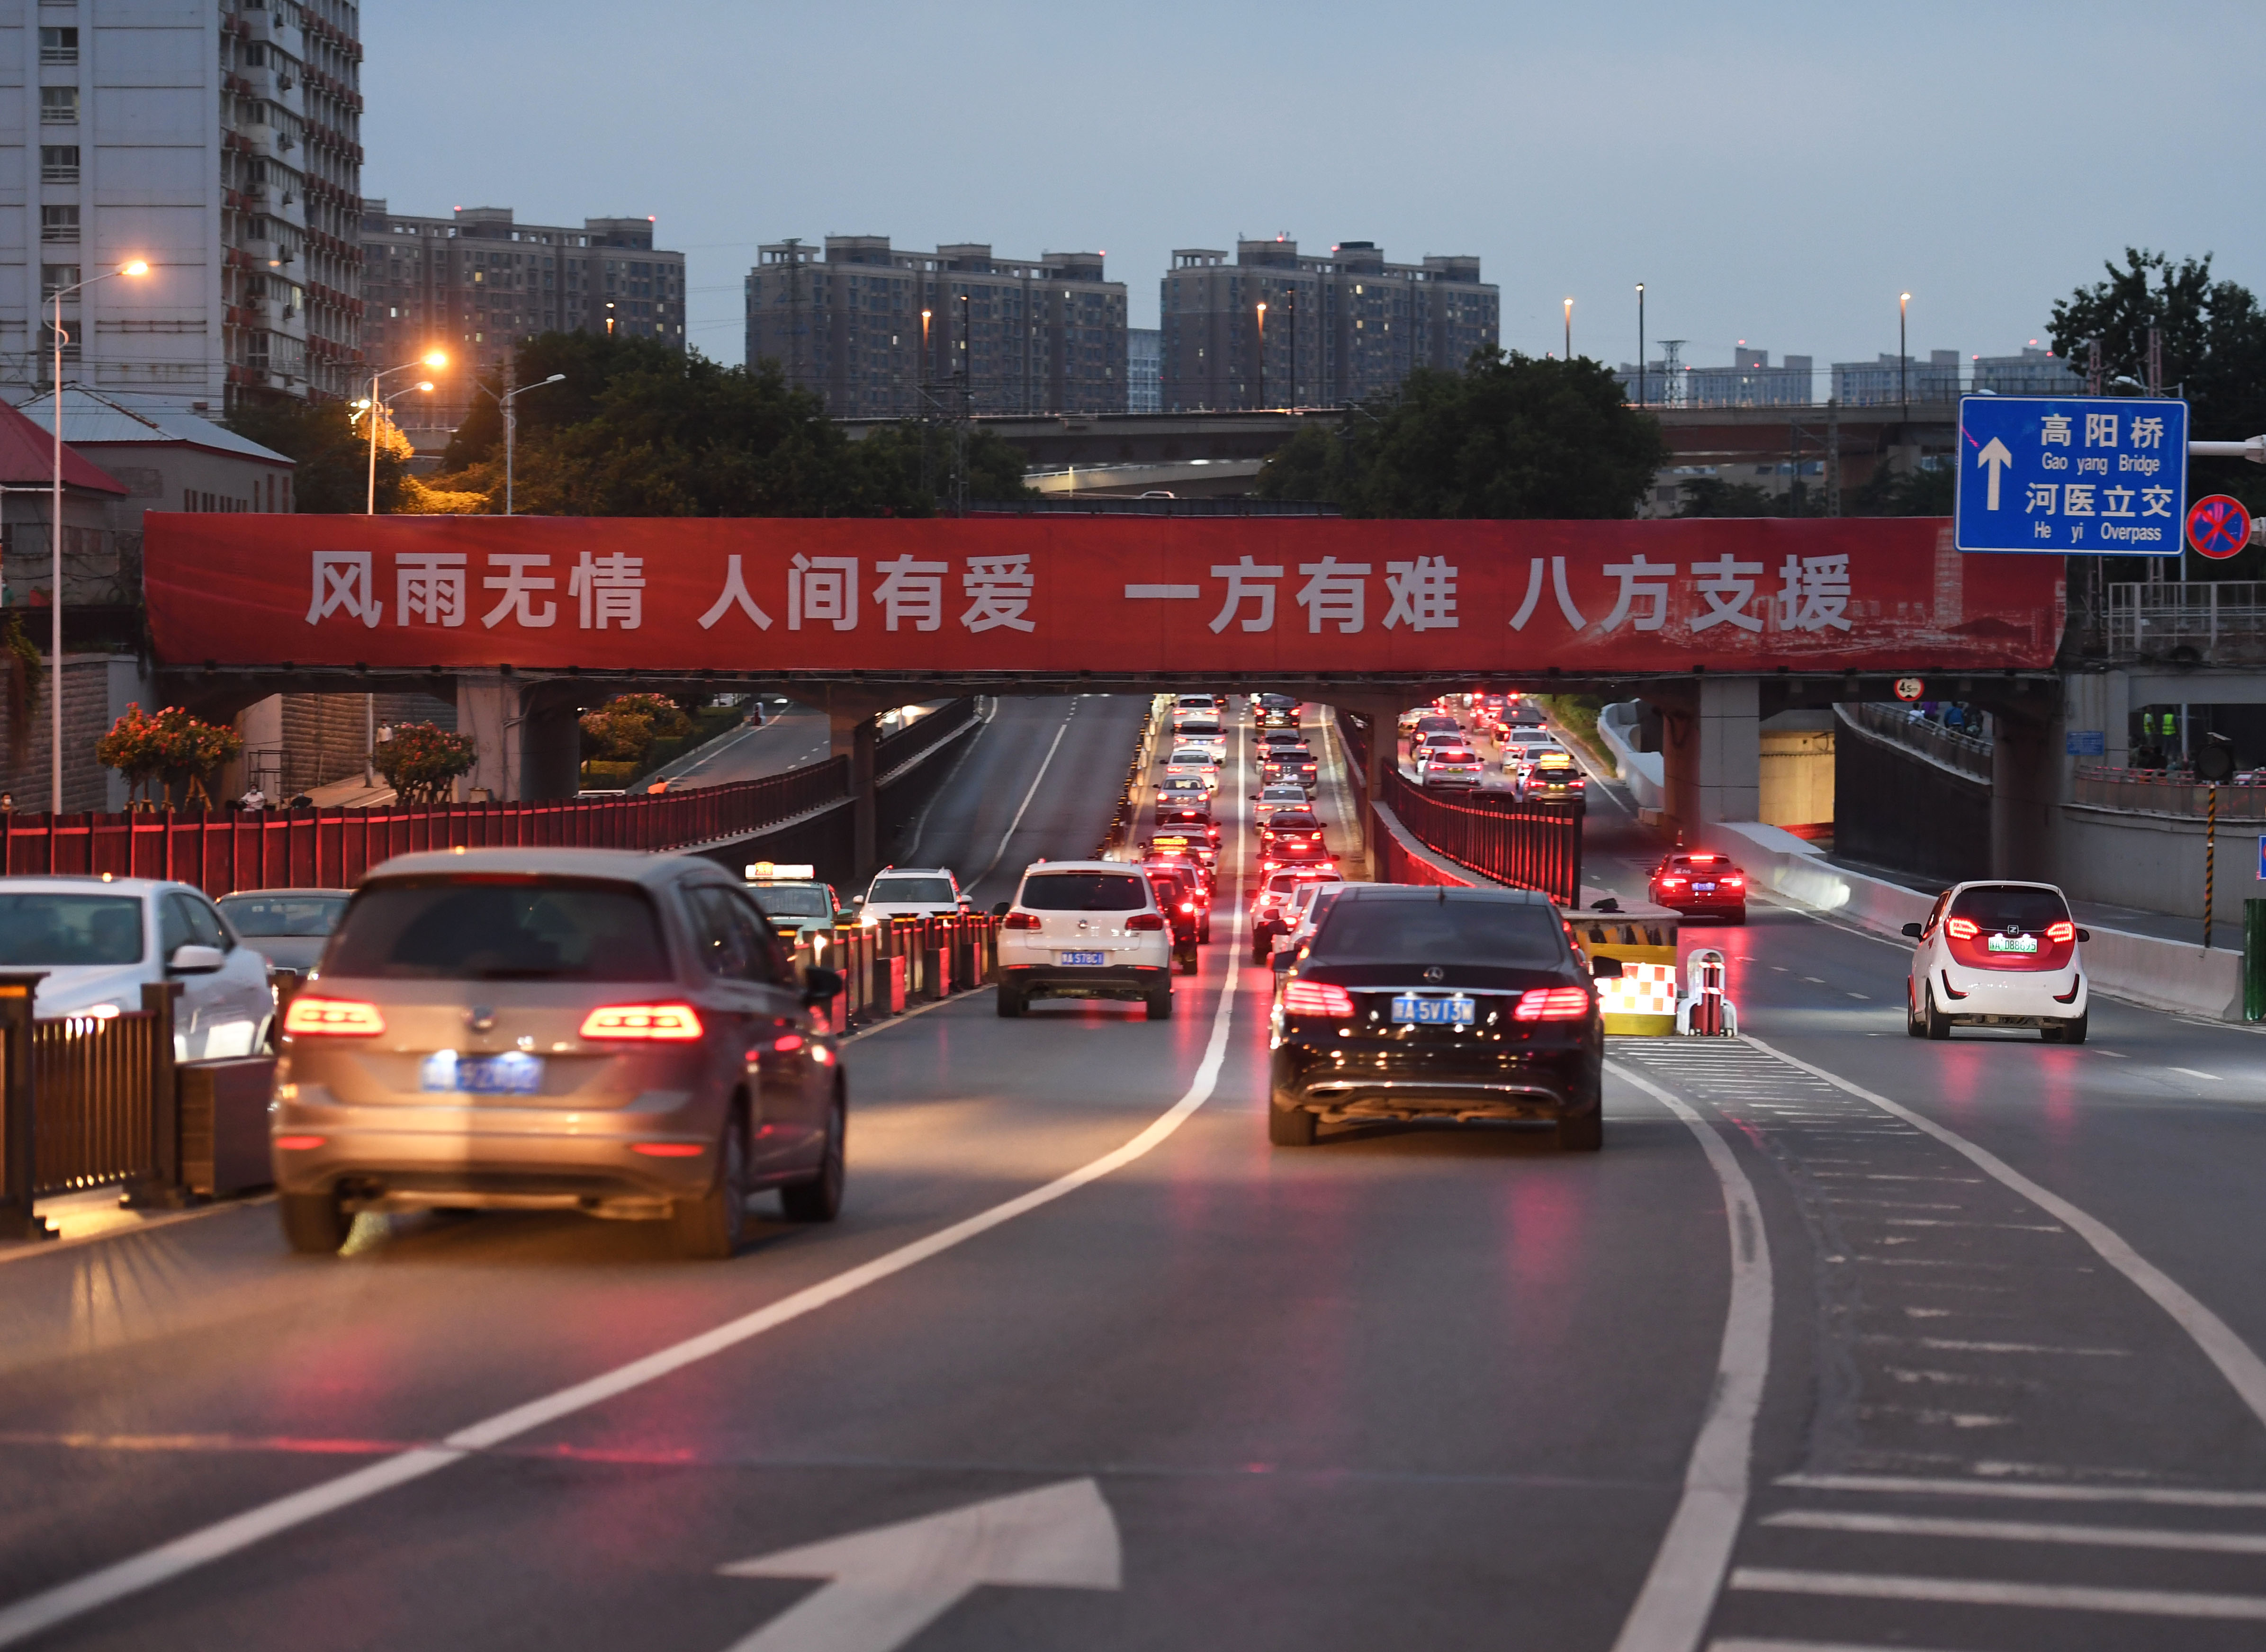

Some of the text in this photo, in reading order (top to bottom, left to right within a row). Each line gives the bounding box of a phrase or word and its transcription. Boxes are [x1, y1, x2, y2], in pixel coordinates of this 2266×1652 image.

[2041, 413, 2164, 449] 高阳桥
[2042, 452, 2160, 476] Gao yang Bridge
[2025, 482, 2174, 517] 河医立交
[2034, 521, 2162, 544] He yi Overpass
[306, 551, 1852, 633] 风雨无情 人间有爱 一方有难 八方支援
